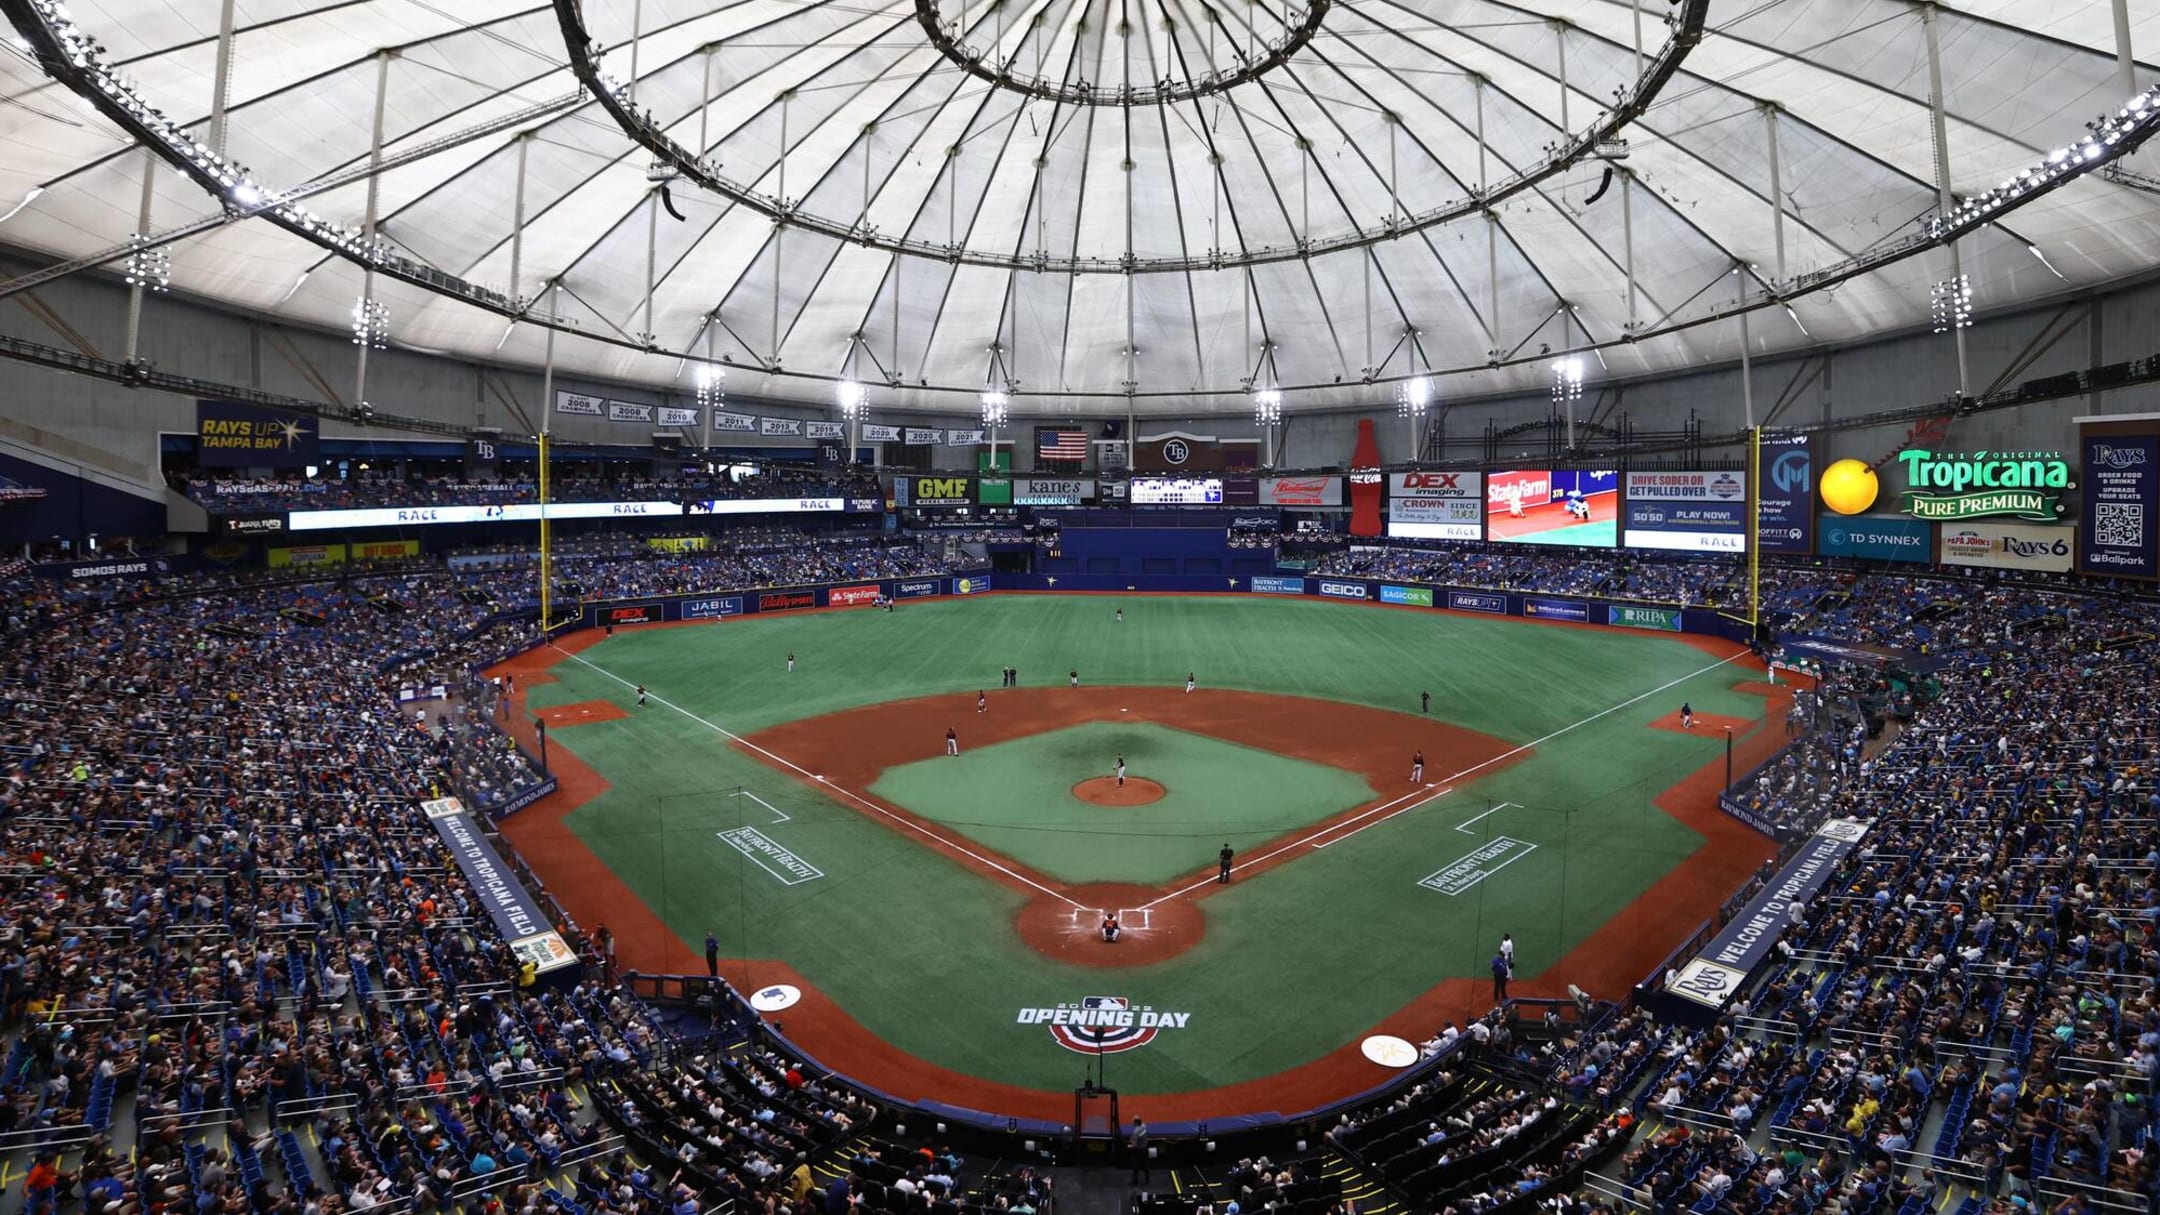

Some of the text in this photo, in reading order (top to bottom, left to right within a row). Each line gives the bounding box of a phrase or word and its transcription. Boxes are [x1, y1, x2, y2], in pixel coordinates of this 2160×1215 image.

[568, 400, 590, 408] 2008
[619, 407, 641, 415] 2008
[202, 420, 279, 436] RAYS UP
[202, 436, 282, 449] TAMPA BAY
[823, 446, 838, 460] TB
[1168, 443, 1185, 460] TB
[1899, 450, 2068, 491] Tropicana
[1028, 481, 1081, 493] kane's
[1403, 474, 1461, 488] DEX
[1632, 476, 1704, 485] DRIVE SOBER OR
[918, 479, 968, 498] GMF
[1416, 488, 1465, 496] imaging
[1630, 487, 1646, 496] GET
[1647, 487, 1680, 496] PULLED
[1682, 487, 1706, 496] OVER
[613, 504, 648, 513] RACE
[800, 500, 831, 509] RACE
[1403, 500, 1446, 508] CROWN
[1913, 495, 2043, 515] PURE PREMIUM
[398, 510, 438, 521] RACE
[1676, 511, 1731, 519] PLAY NOW!
[1849, 533, 1921, 546] TD SYNNEX
[2051, 539, 2069, 556] 6
[2101, 554, 2144, 566] Ballpark
[72, 567, 116, 577] SOMOS
[117, 563, 148, 573] RAYS
[901, 583, 932, 592] Spectrum
[1321, 583, 1365, 597] GEICO
[1383, 590, 1420, 600] SAGICOR
[1457, 597, 1478, 606] RAYS
[692, 599, 733, 611] JABIL
[611, 607, 646, 619] DEX
[1636, 610, 1667, 623] RIPA
[1721, 799, 1776, 837] RAYMOND JAMES
[443, 815, 538, 936] WELCOME TO TROPICANA FIELD
[1426, 857, 1479, 887] BAYFRONT
[1716, 839, 1841, 964] WELCOME TO TROPICANA FIELD
[1017, 1008, 1191, 1028] OPENING DAY
